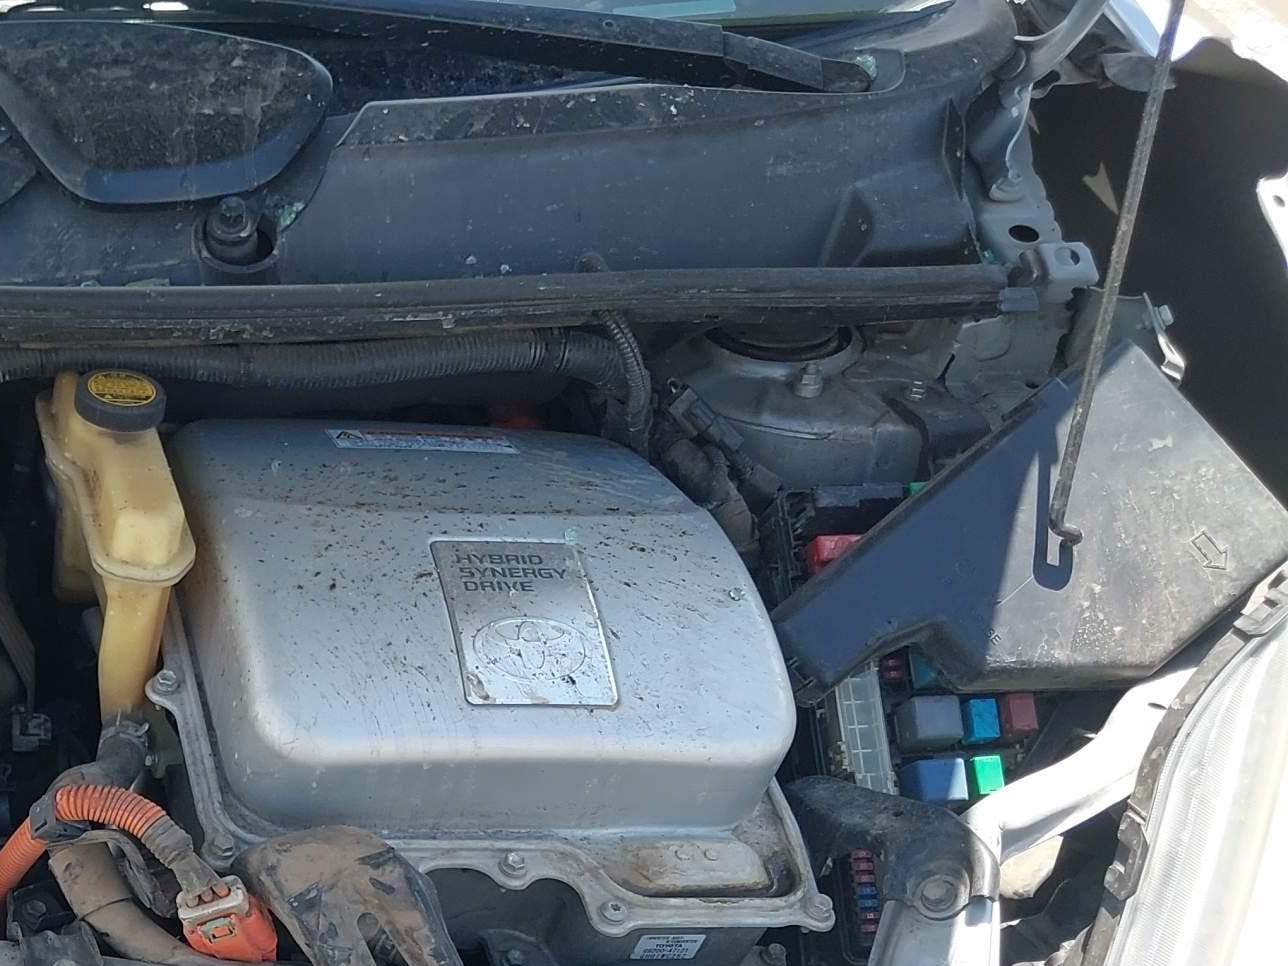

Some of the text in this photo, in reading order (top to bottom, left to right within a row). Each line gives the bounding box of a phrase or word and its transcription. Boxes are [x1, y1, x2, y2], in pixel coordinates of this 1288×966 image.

[456, 554, 543, 566] HYBRID
[459, 567, 566, 580] SYNERGY
[463, 580, 535, 592] DRIVE
